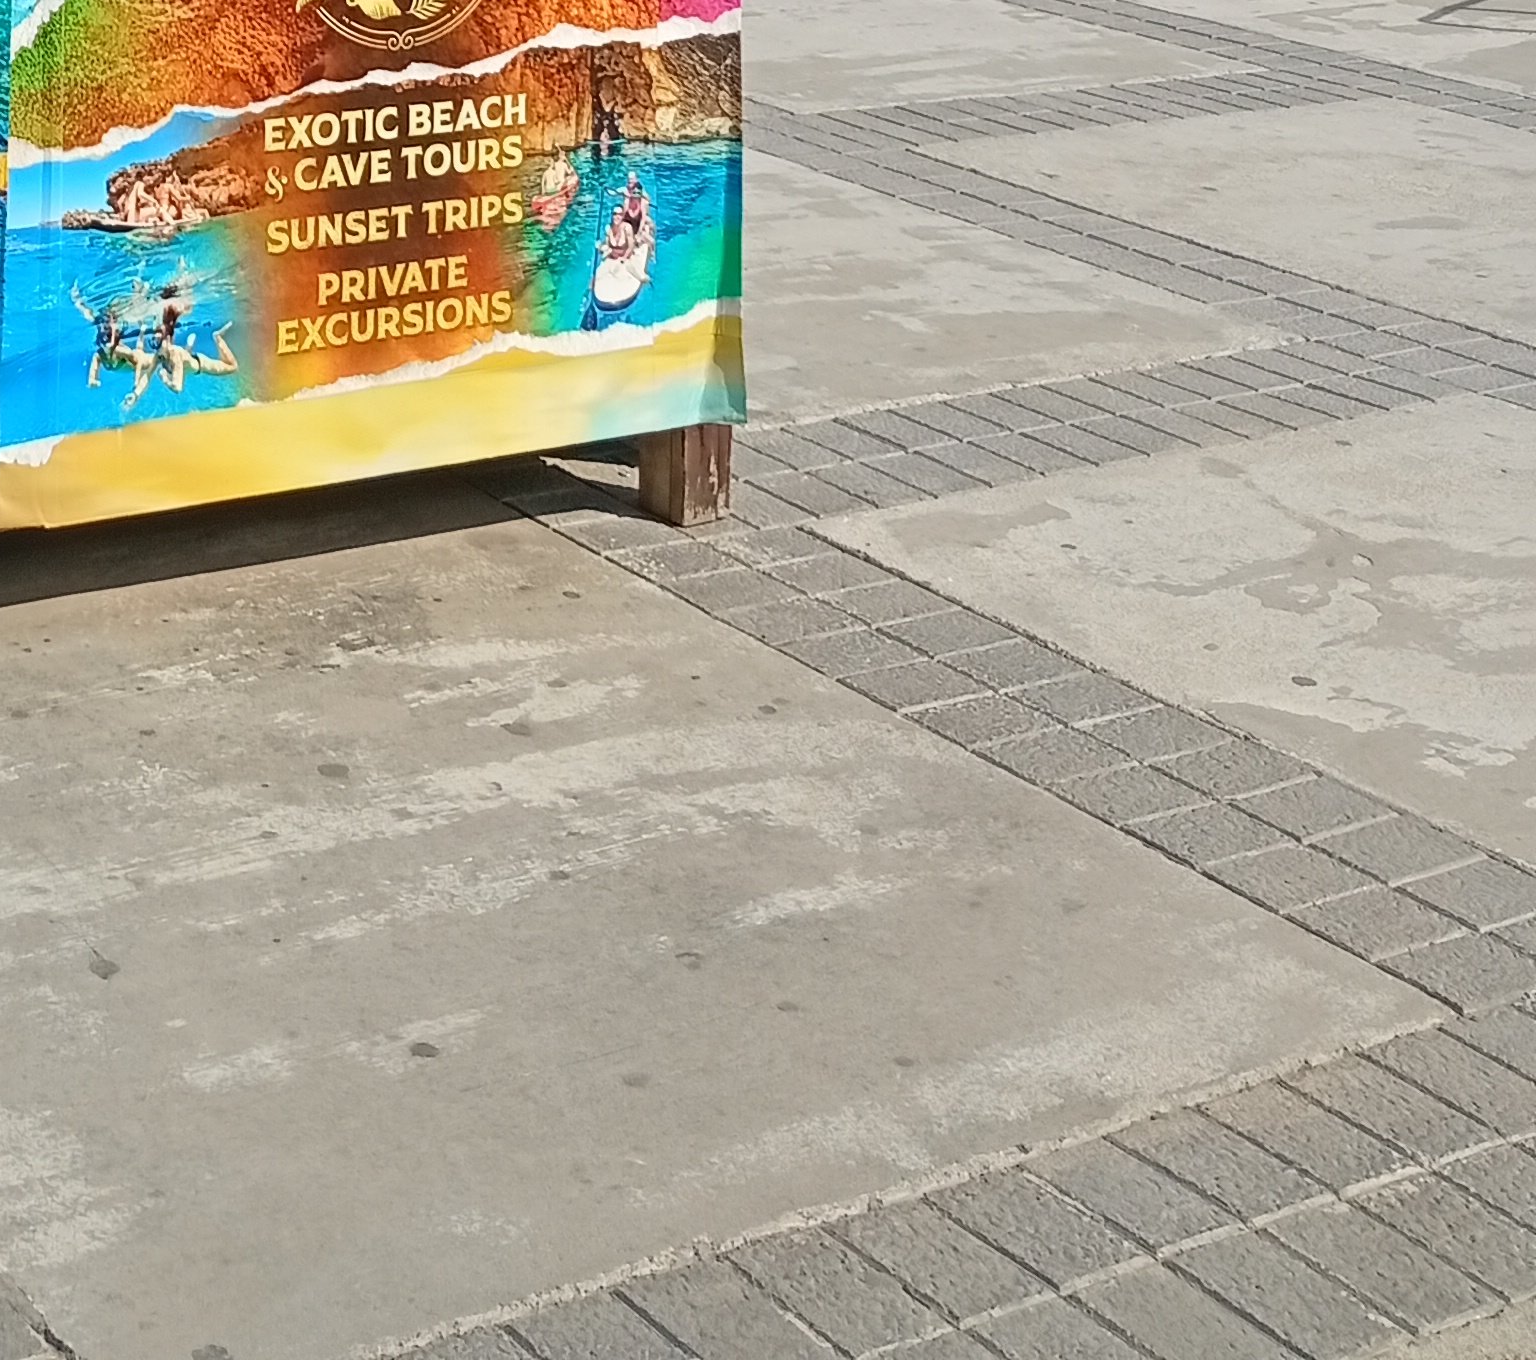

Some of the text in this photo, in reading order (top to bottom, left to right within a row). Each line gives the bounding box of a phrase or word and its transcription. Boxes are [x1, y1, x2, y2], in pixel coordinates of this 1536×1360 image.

[264, 93, 528, 152] EXOTIC BEACH
[264, 135, 524, 203] & CAVE TOURS
[266, 191, 524, 255] SUNSET TRIPS
[317, 254, 469, 307] PRIVATE
[275, 290, 512, 355] EXCURSIONS
